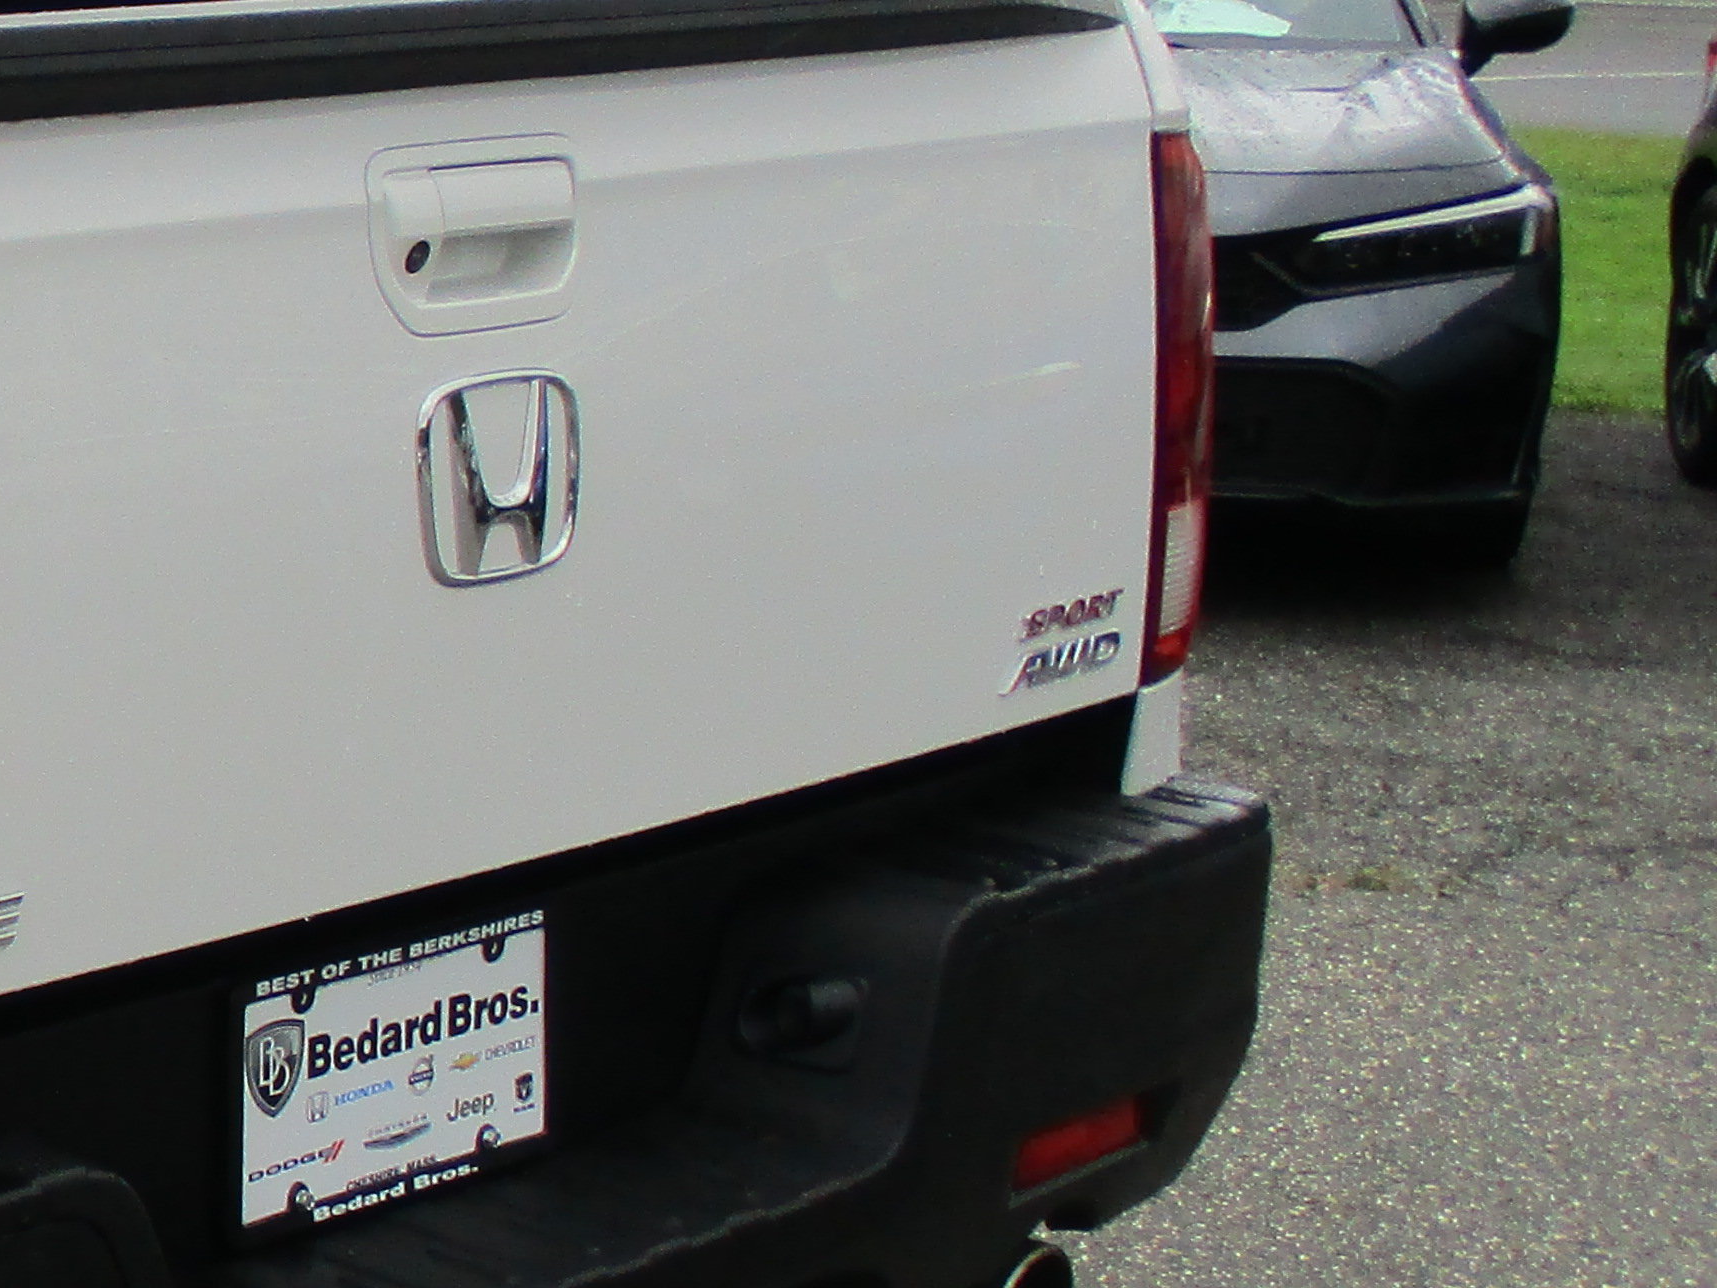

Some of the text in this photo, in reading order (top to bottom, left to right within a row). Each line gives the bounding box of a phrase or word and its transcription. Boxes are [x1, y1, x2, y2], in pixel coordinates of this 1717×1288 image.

[1018, 586, 1125, 643] SPORT
[997, 628, 1121, 698] AWD
[255, 969, 315, 998] BEST
[321, 958, 352, 980] OF
[358, 947, 403, 971] THE
[408, 910, 545, 958] BERKSHIRES
[334, 1079, 395, 1107] HONDA
[445, 1092, 495, 1122] Jeep
[312, 1163, 480, 1223] Bedard Bros.
